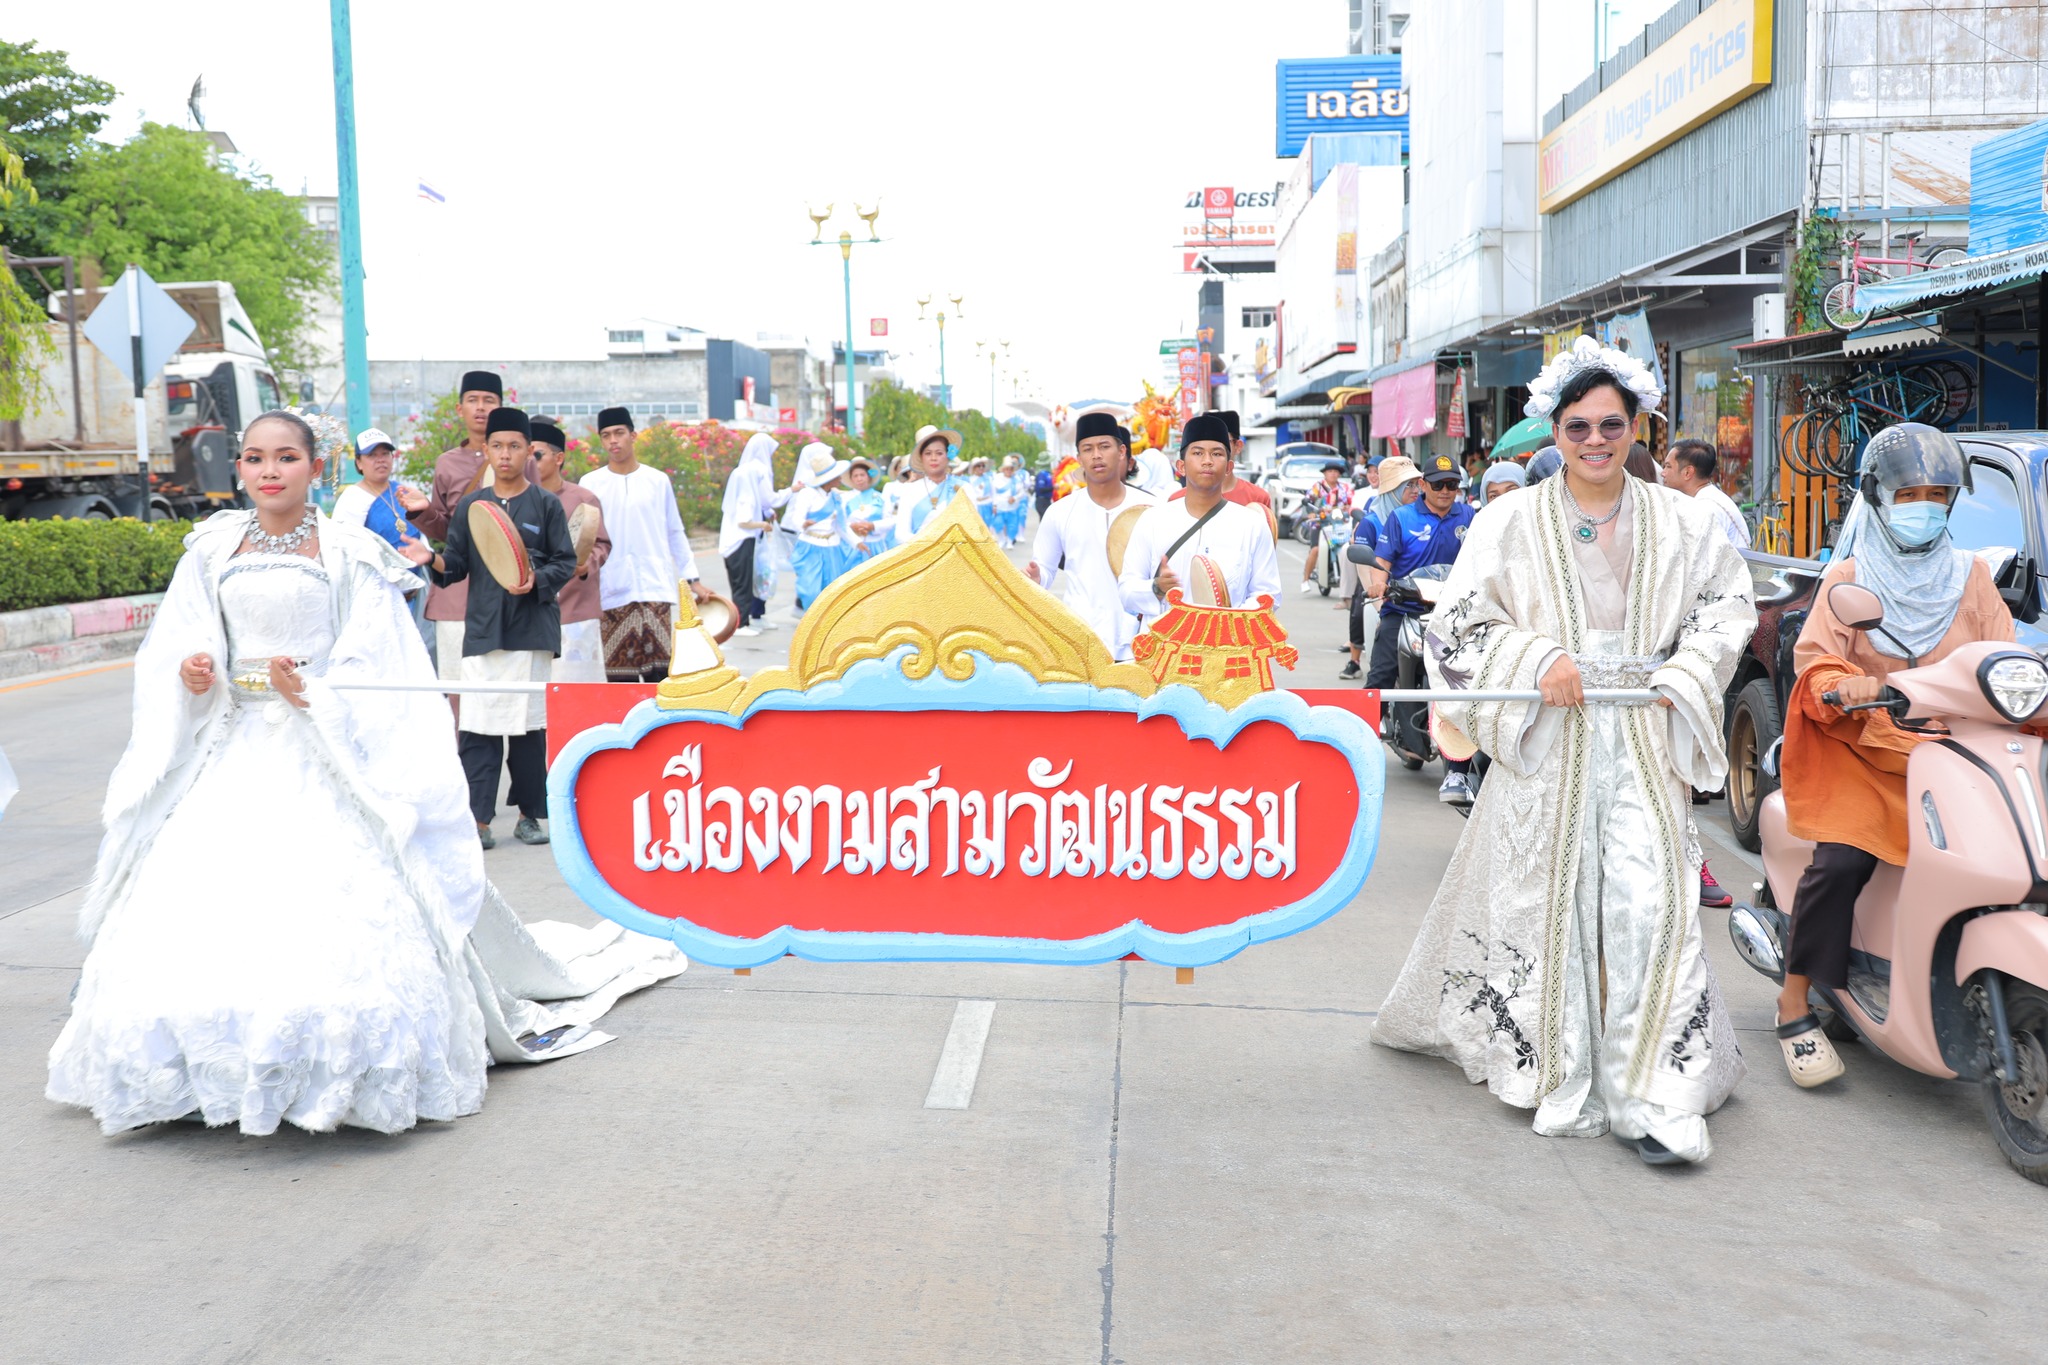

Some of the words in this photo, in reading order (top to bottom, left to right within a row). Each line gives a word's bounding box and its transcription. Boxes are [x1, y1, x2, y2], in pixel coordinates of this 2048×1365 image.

[1603, 90, 1652, 151] Always
[1654, 64, 1686, 116] Low
[1688, 20, 1746, 94] Prices
[1929, 272, 1957, 290] REPAIR
[1966, 264, 1990, 282] ROAD
[1991, 259, 2011, 277] BIKE
[632, 743, 1301, 881] เมืองงามสามวัฒนธรรม
